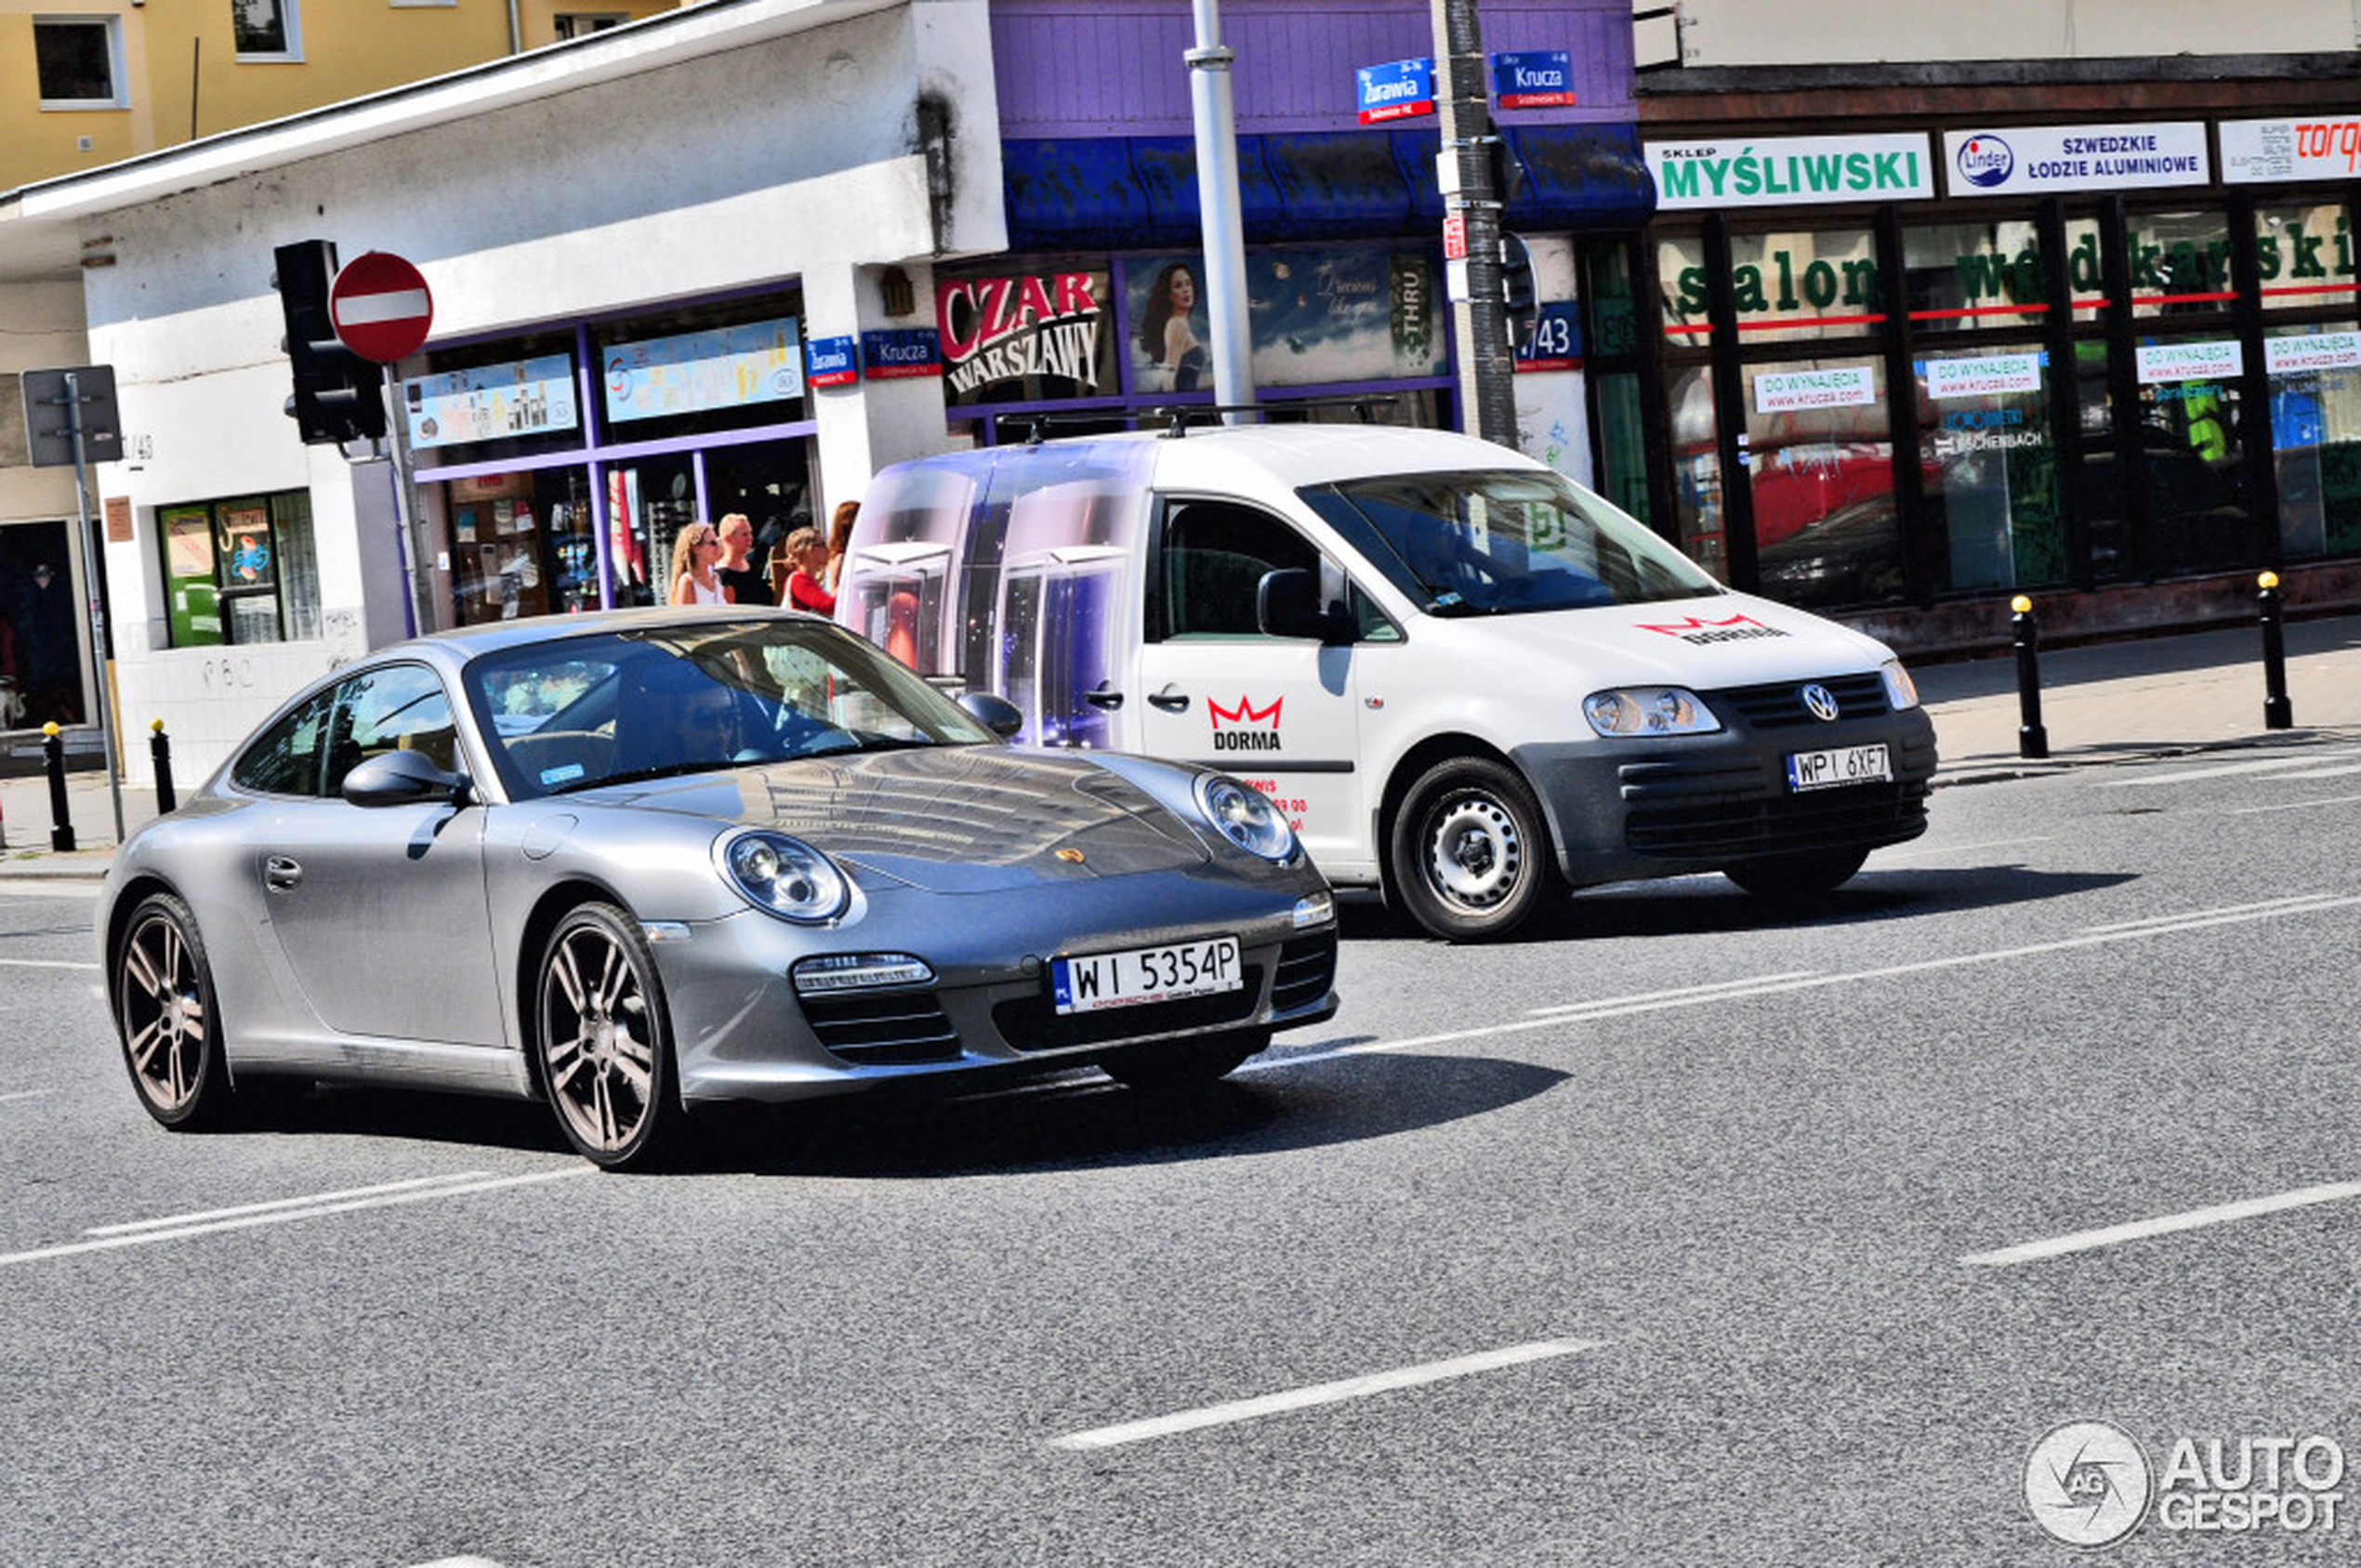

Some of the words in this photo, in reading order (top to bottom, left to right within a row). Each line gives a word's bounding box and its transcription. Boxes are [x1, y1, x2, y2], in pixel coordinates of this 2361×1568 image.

[1515, 66, 1563, 88] Krucza
[1365, 76, 1418, 104] Żurawia
[1662, 147, 1717, 159] SKLEP
[2063, 135, 2157, 155] SZWEDZKIE
[2294, 122, 2361, 174] torq
[1964, 149, 2008, 169] Linder
[2028, 161, 2089, 178] ŁODZIE
[2094, 155, 2199, 177] ALUMINIOWE
[1662, 147, 1919, 198] MYŚLIWSKI
[1677, 250, 1879, 315] salon
[934, 271, 1101, 362] CZAR
[879, 343, 929, 362] Krucza
[948, 322, 1098, 394] WARSZAWY
[1939, 364, 1957, 379] DO
[1764, 376, 1784, 393] DO
[1939, 377, 2032, 393] www.krucza.com
[1767, 390, 1864, 407] www.krucza.com
[1214, 731, 1281, 750] DORMA
[1847, 746, 1886, 777] 6XF7
[1075, 958, 1119, 999] WI
[1141, 942, 1234, 991] 5354P
